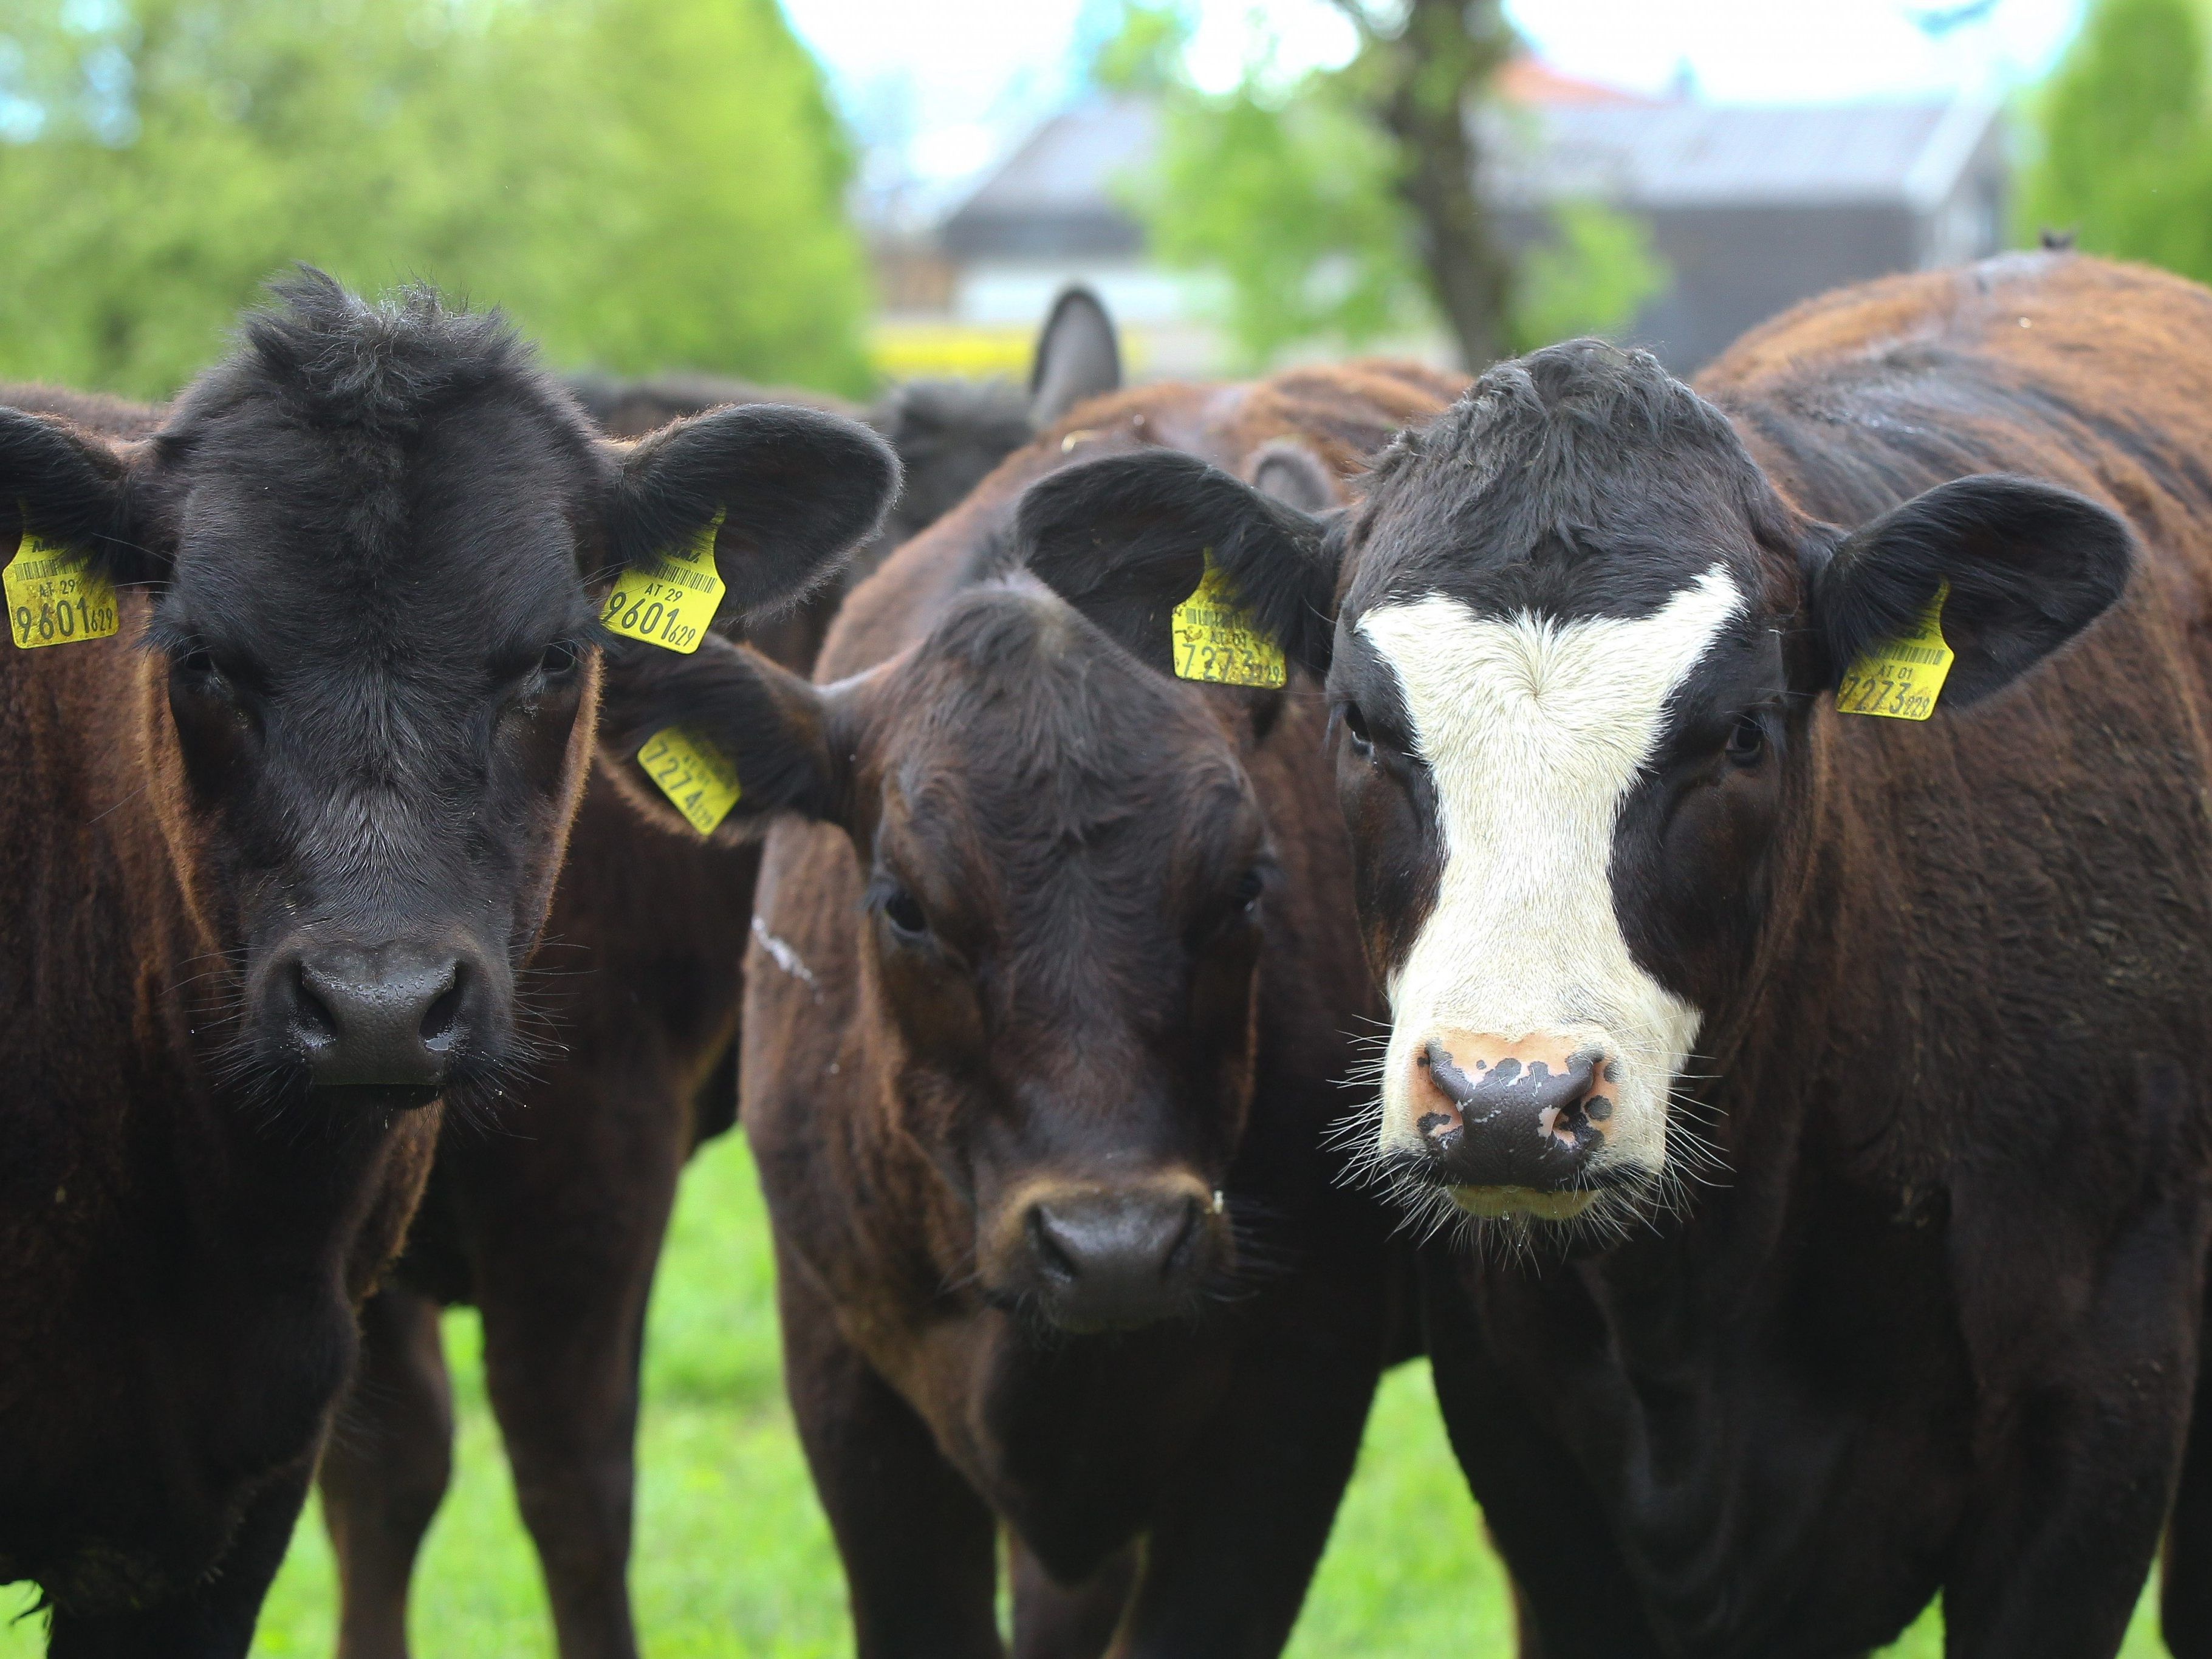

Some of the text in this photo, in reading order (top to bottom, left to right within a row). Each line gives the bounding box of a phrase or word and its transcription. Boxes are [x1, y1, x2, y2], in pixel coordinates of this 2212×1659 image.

[60, 580, 76, 595] 29
[645, 583, 683, 603] AT 29
[1878, 663, 1895, 677] AT
